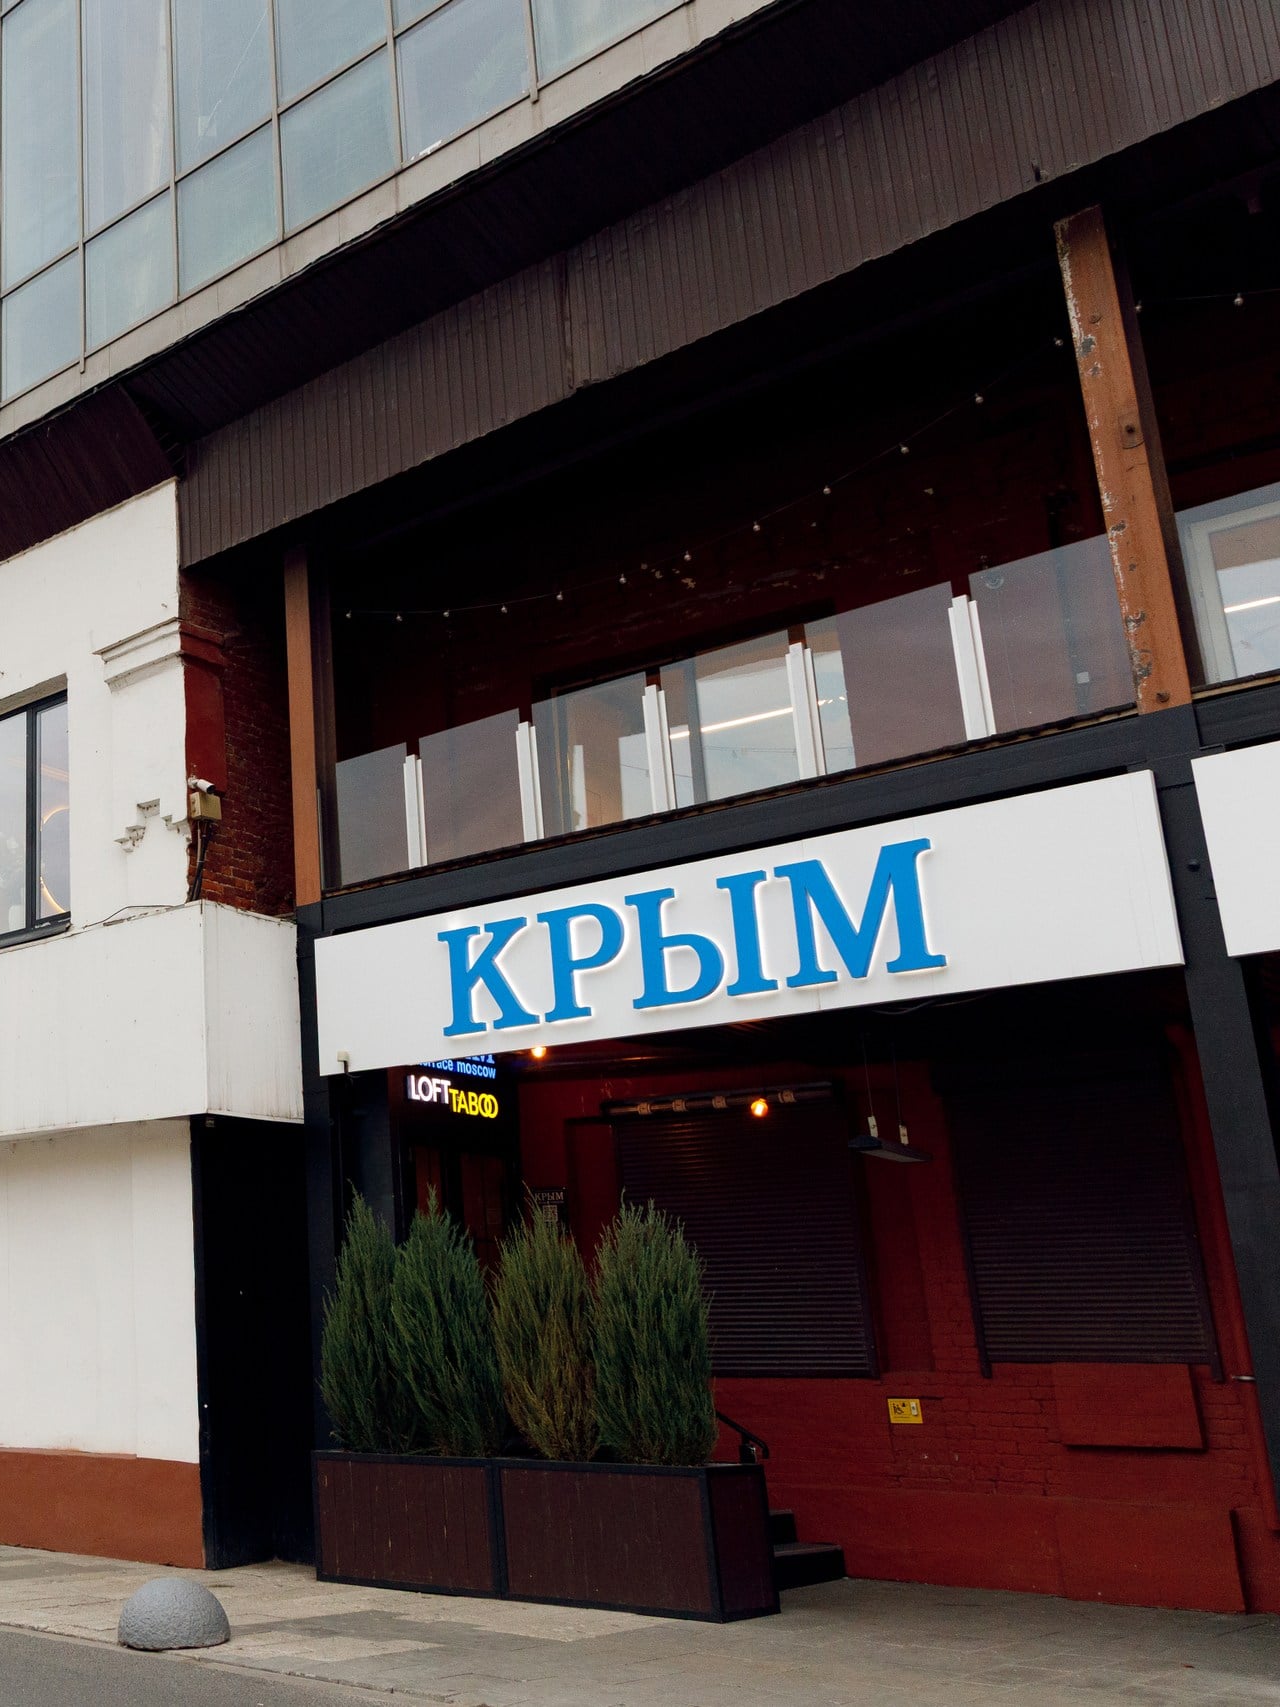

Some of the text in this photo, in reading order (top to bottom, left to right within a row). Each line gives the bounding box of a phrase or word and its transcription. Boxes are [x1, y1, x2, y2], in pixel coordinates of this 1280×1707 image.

[437, 837, 947, 1037] КРЫМ
[456, 1061, 496, 1080] moscow
[409, 1074, 499, 1119] LOFT TABOO
[534, 1191, 565, 1201] КРЫМ
